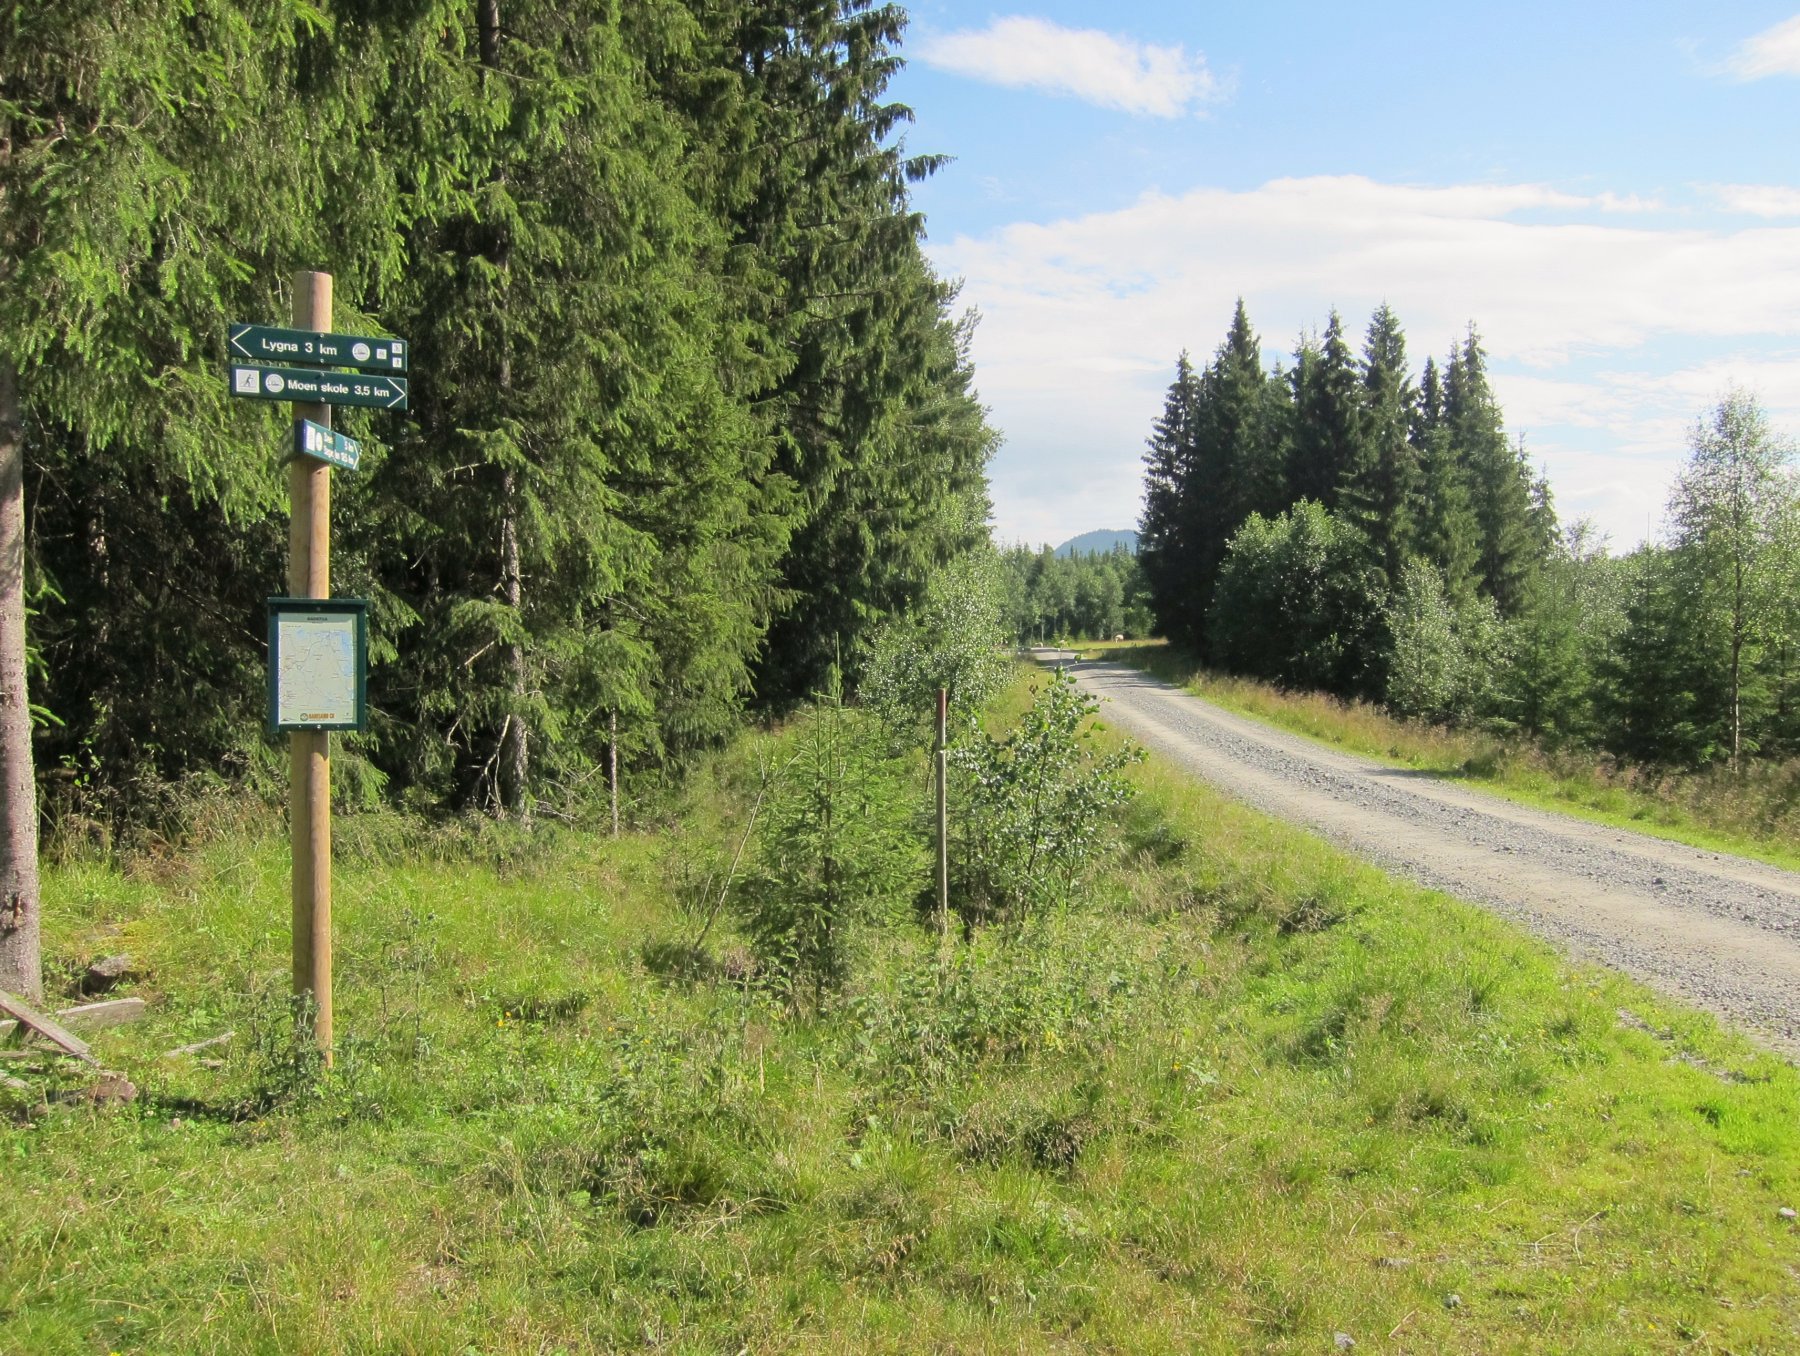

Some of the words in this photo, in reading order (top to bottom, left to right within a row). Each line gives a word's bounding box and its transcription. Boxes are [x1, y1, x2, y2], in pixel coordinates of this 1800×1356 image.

[262, 338, 298, 353] Lygna
[305, 342, 313, 353] 3
[320, 344, 337, 356] km
[288, 380, 317, 392] Moen
[321, 382, 349, 394] skole
[374, 387, 390, 397] km
